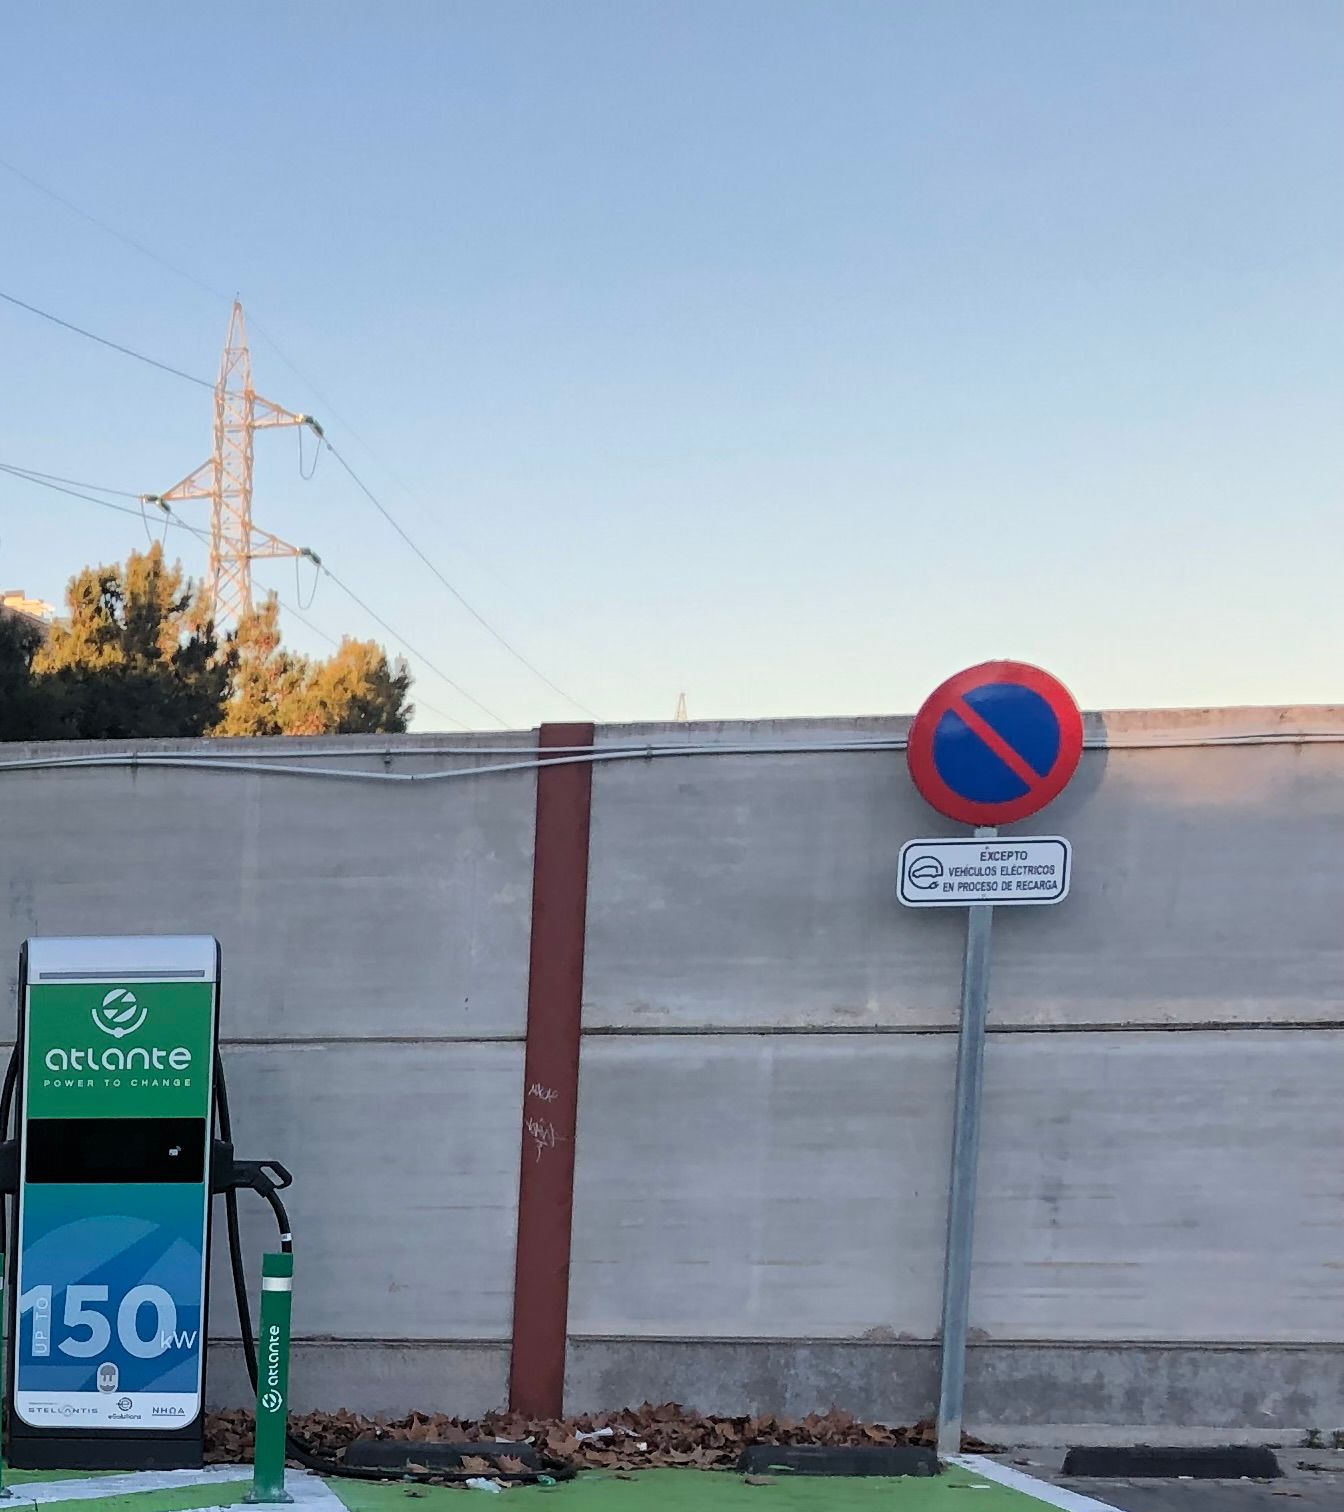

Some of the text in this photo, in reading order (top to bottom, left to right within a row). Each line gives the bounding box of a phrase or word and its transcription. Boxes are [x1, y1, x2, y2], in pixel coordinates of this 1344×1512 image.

[980, 851, 1028, 861] EXCEPTO
[948, 864, 1056, 877] VEHÍCULOS ELÉCTRICOS
[943, 880, 1058, 892] EN PROCESO DE RECARGA
[45, 1047, 192, 1071] atlante
[44, 1078, 191, 1087] POWER TO CHANGE
[20, 1284, 177, 1359] 150
[34, 1298, 48, 1354] UP TO
[161, 1330, 198, 1350] kW
[268, 1325, 280, 1387] atlante
[28, 1406, 98, 1415] STELLANTIS
